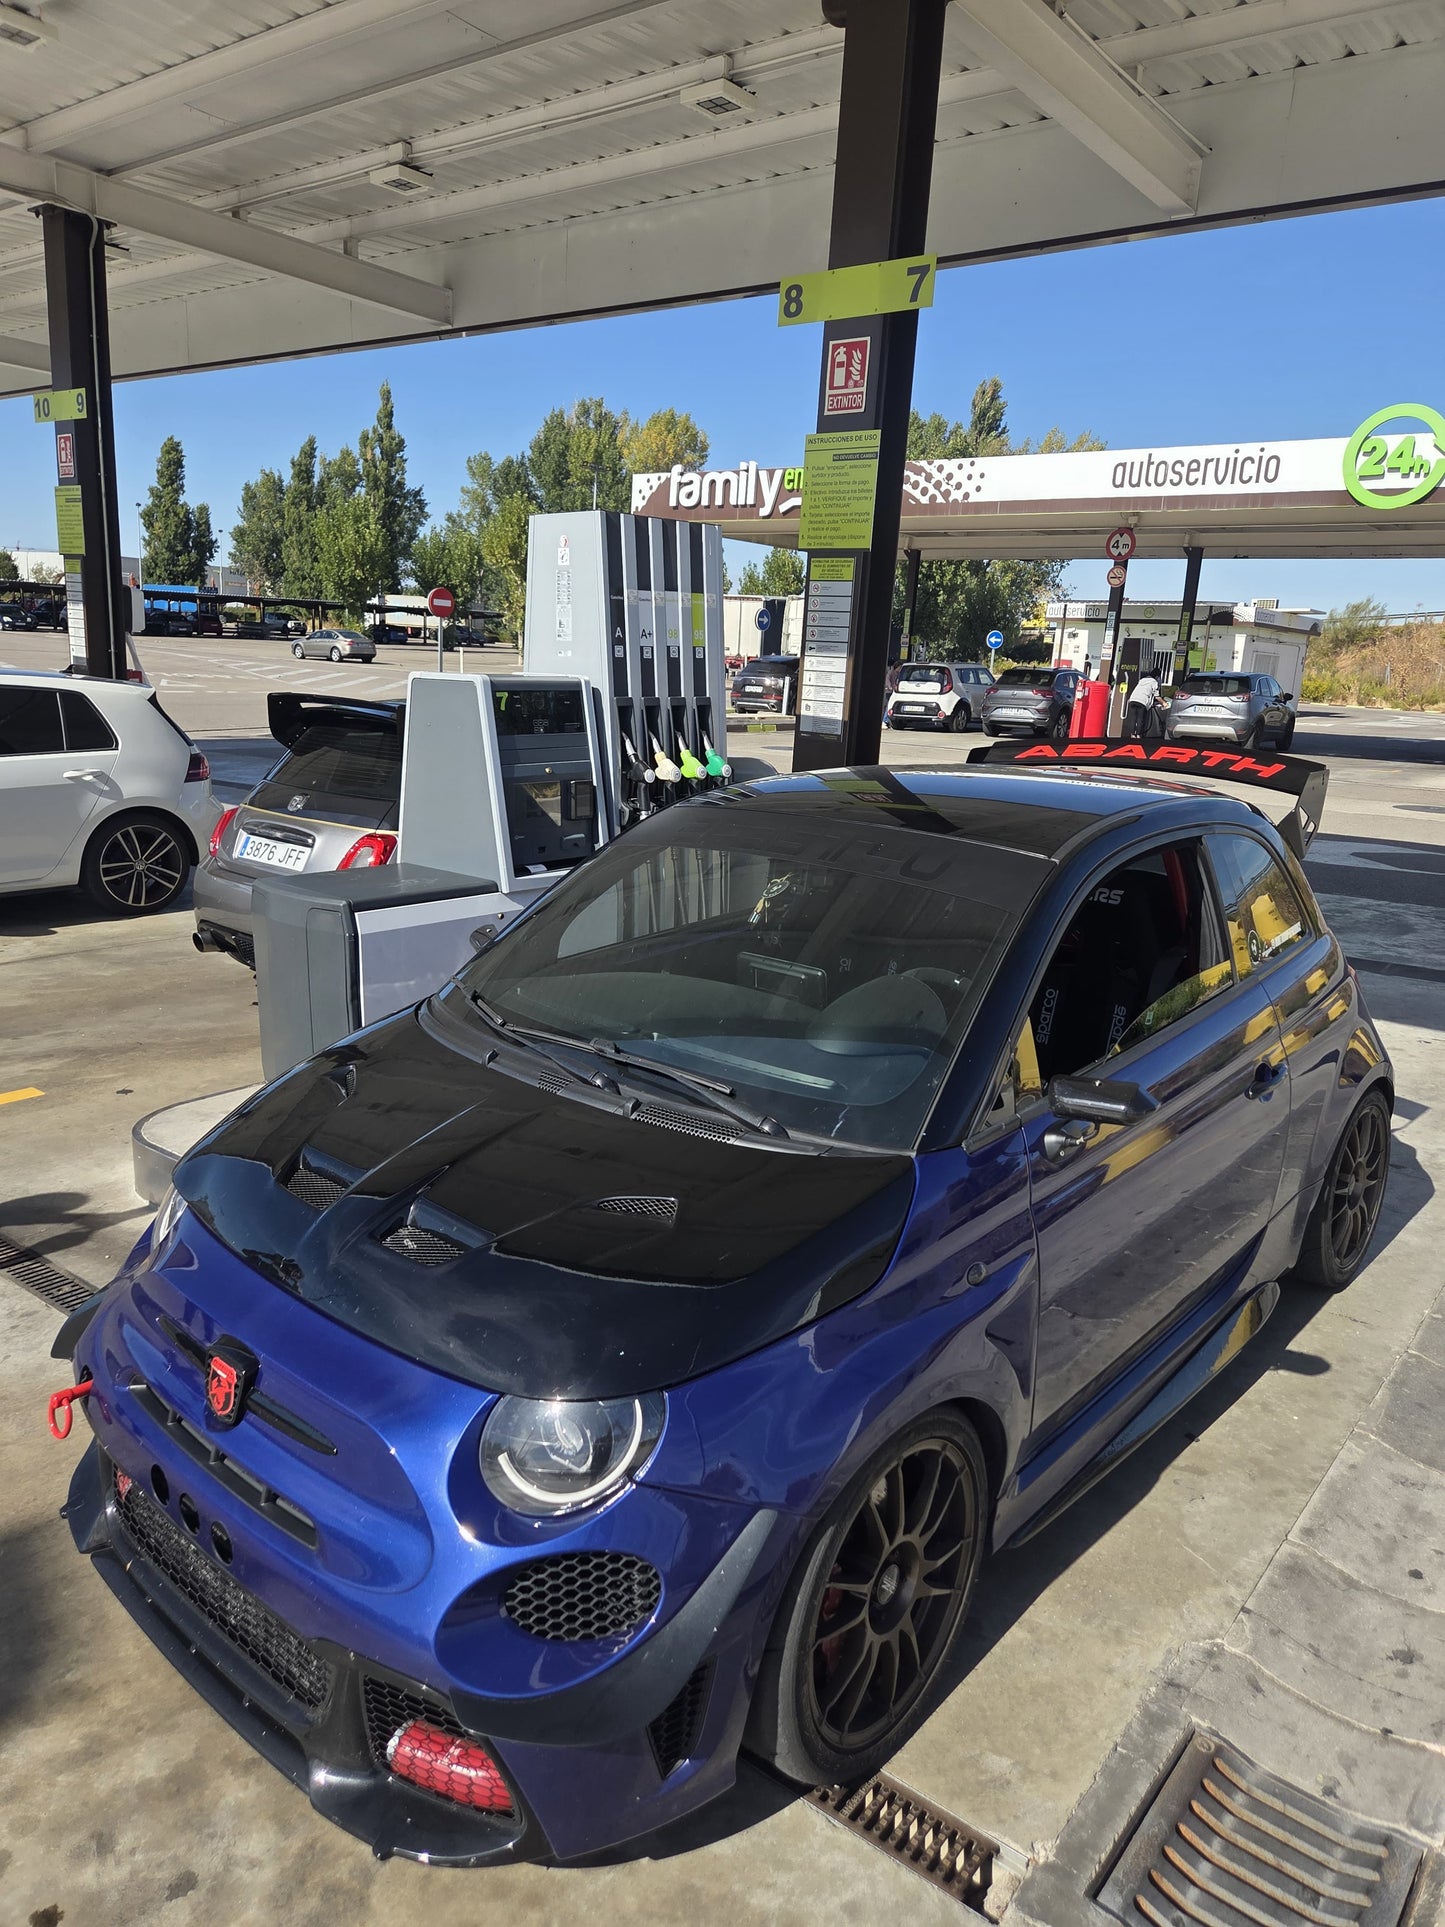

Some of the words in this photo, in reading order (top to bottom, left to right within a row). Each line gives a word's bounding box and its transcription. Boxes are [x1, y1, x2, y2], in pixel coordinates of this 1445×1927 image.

[783, 284, 803, 318] 8
[906, 264, 931, 304] 7
[35, 397, 50, 418] 10
[76, 392, 84, 413] 9
[828, 394, 863, 409] EXTINTOR
[807, 435, 854, 445] INSTRUCCIONES
[864, 433, 878, 441] USO
[1357, 436, 1431, 477] 24h
[1111, 447, 1281, 489] autoservicio
[669, 460, 784, 517] family
[784, 468, 804, 490] en
[1111, 539, 1120, 550] 4
[1048, 605, 1100, 618] autservicio
[615, 627, 623, 638] A
[640, 628, 653, 639] A+
[694, 630, 704, 640] 95
[496, 691, 509, 711] 7
[1014, 744, 1287, 778] ABARTH
[246, 841, 278, 860] 3876
[278, 846, 306, 867] JFF
